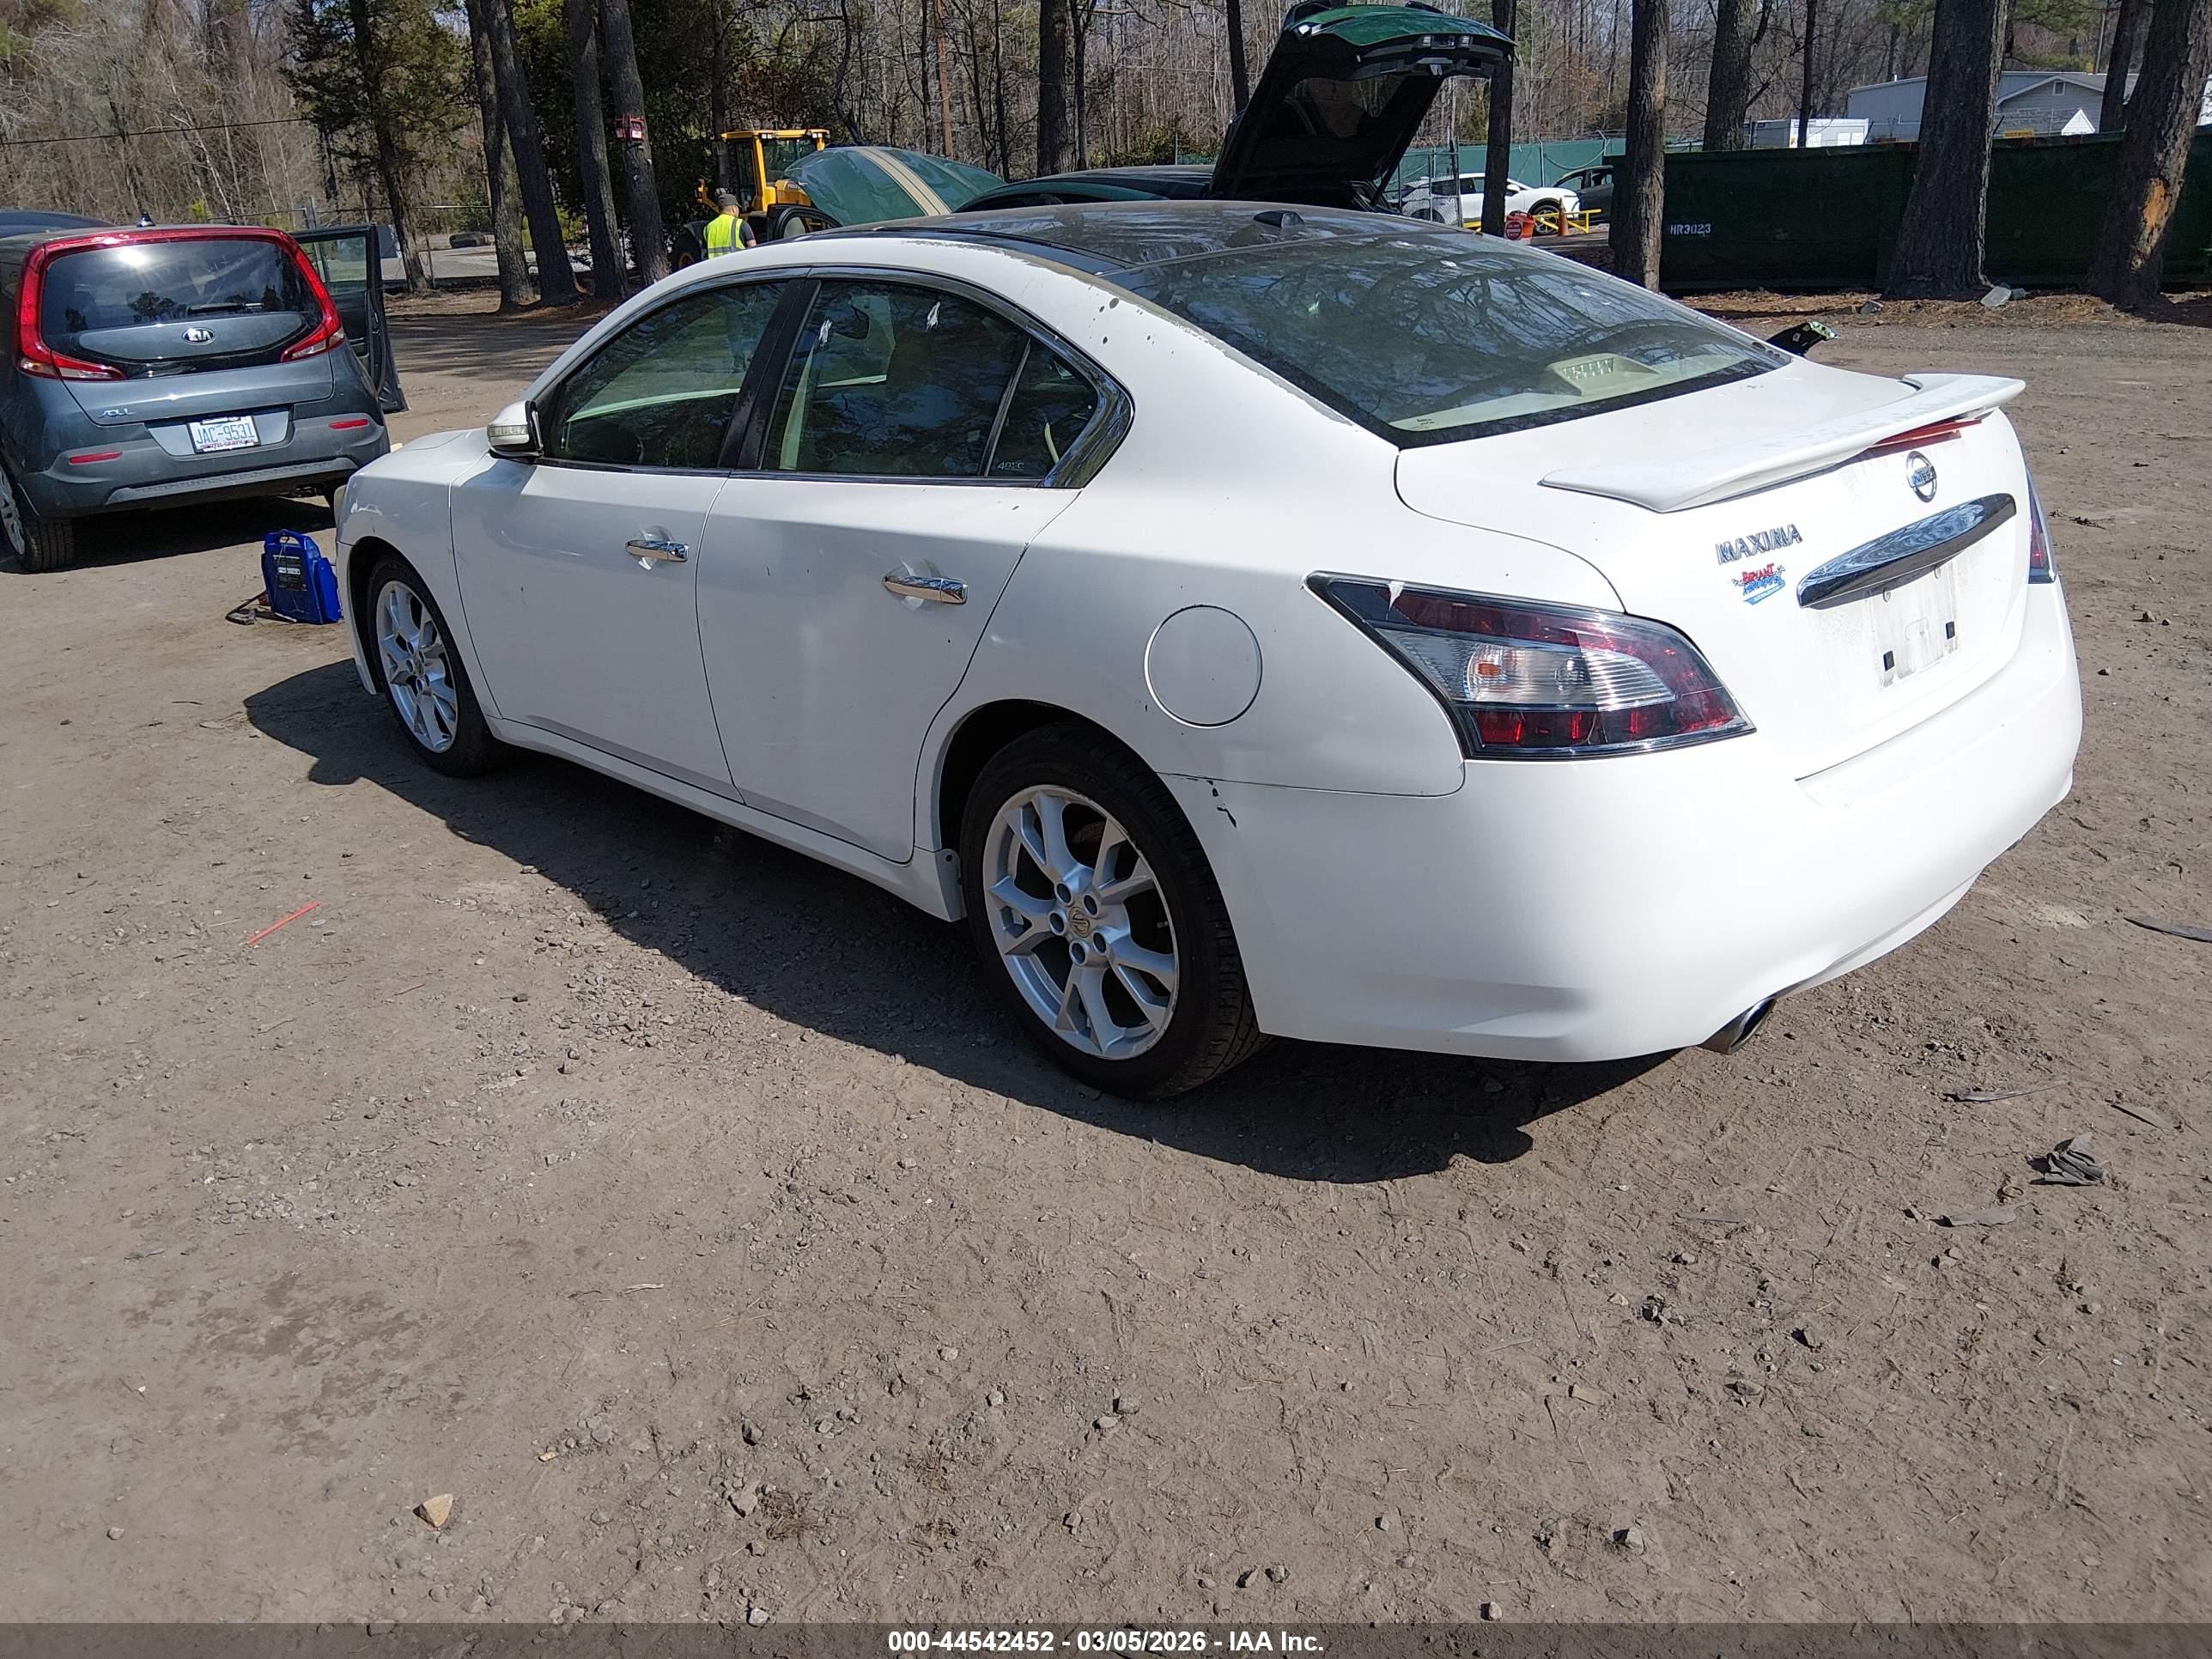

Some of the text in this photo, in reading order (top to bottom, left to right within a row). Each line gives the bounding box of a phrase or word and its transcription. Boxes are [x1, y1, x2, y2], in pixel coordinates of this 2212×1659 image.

[1670, 223, 1711, 235] HR3023
[188, 328, 211, 341] KIA
[196, 422, 255, 444] JAC-9531
[1716, 524, 1803, 565] MAXIMA
